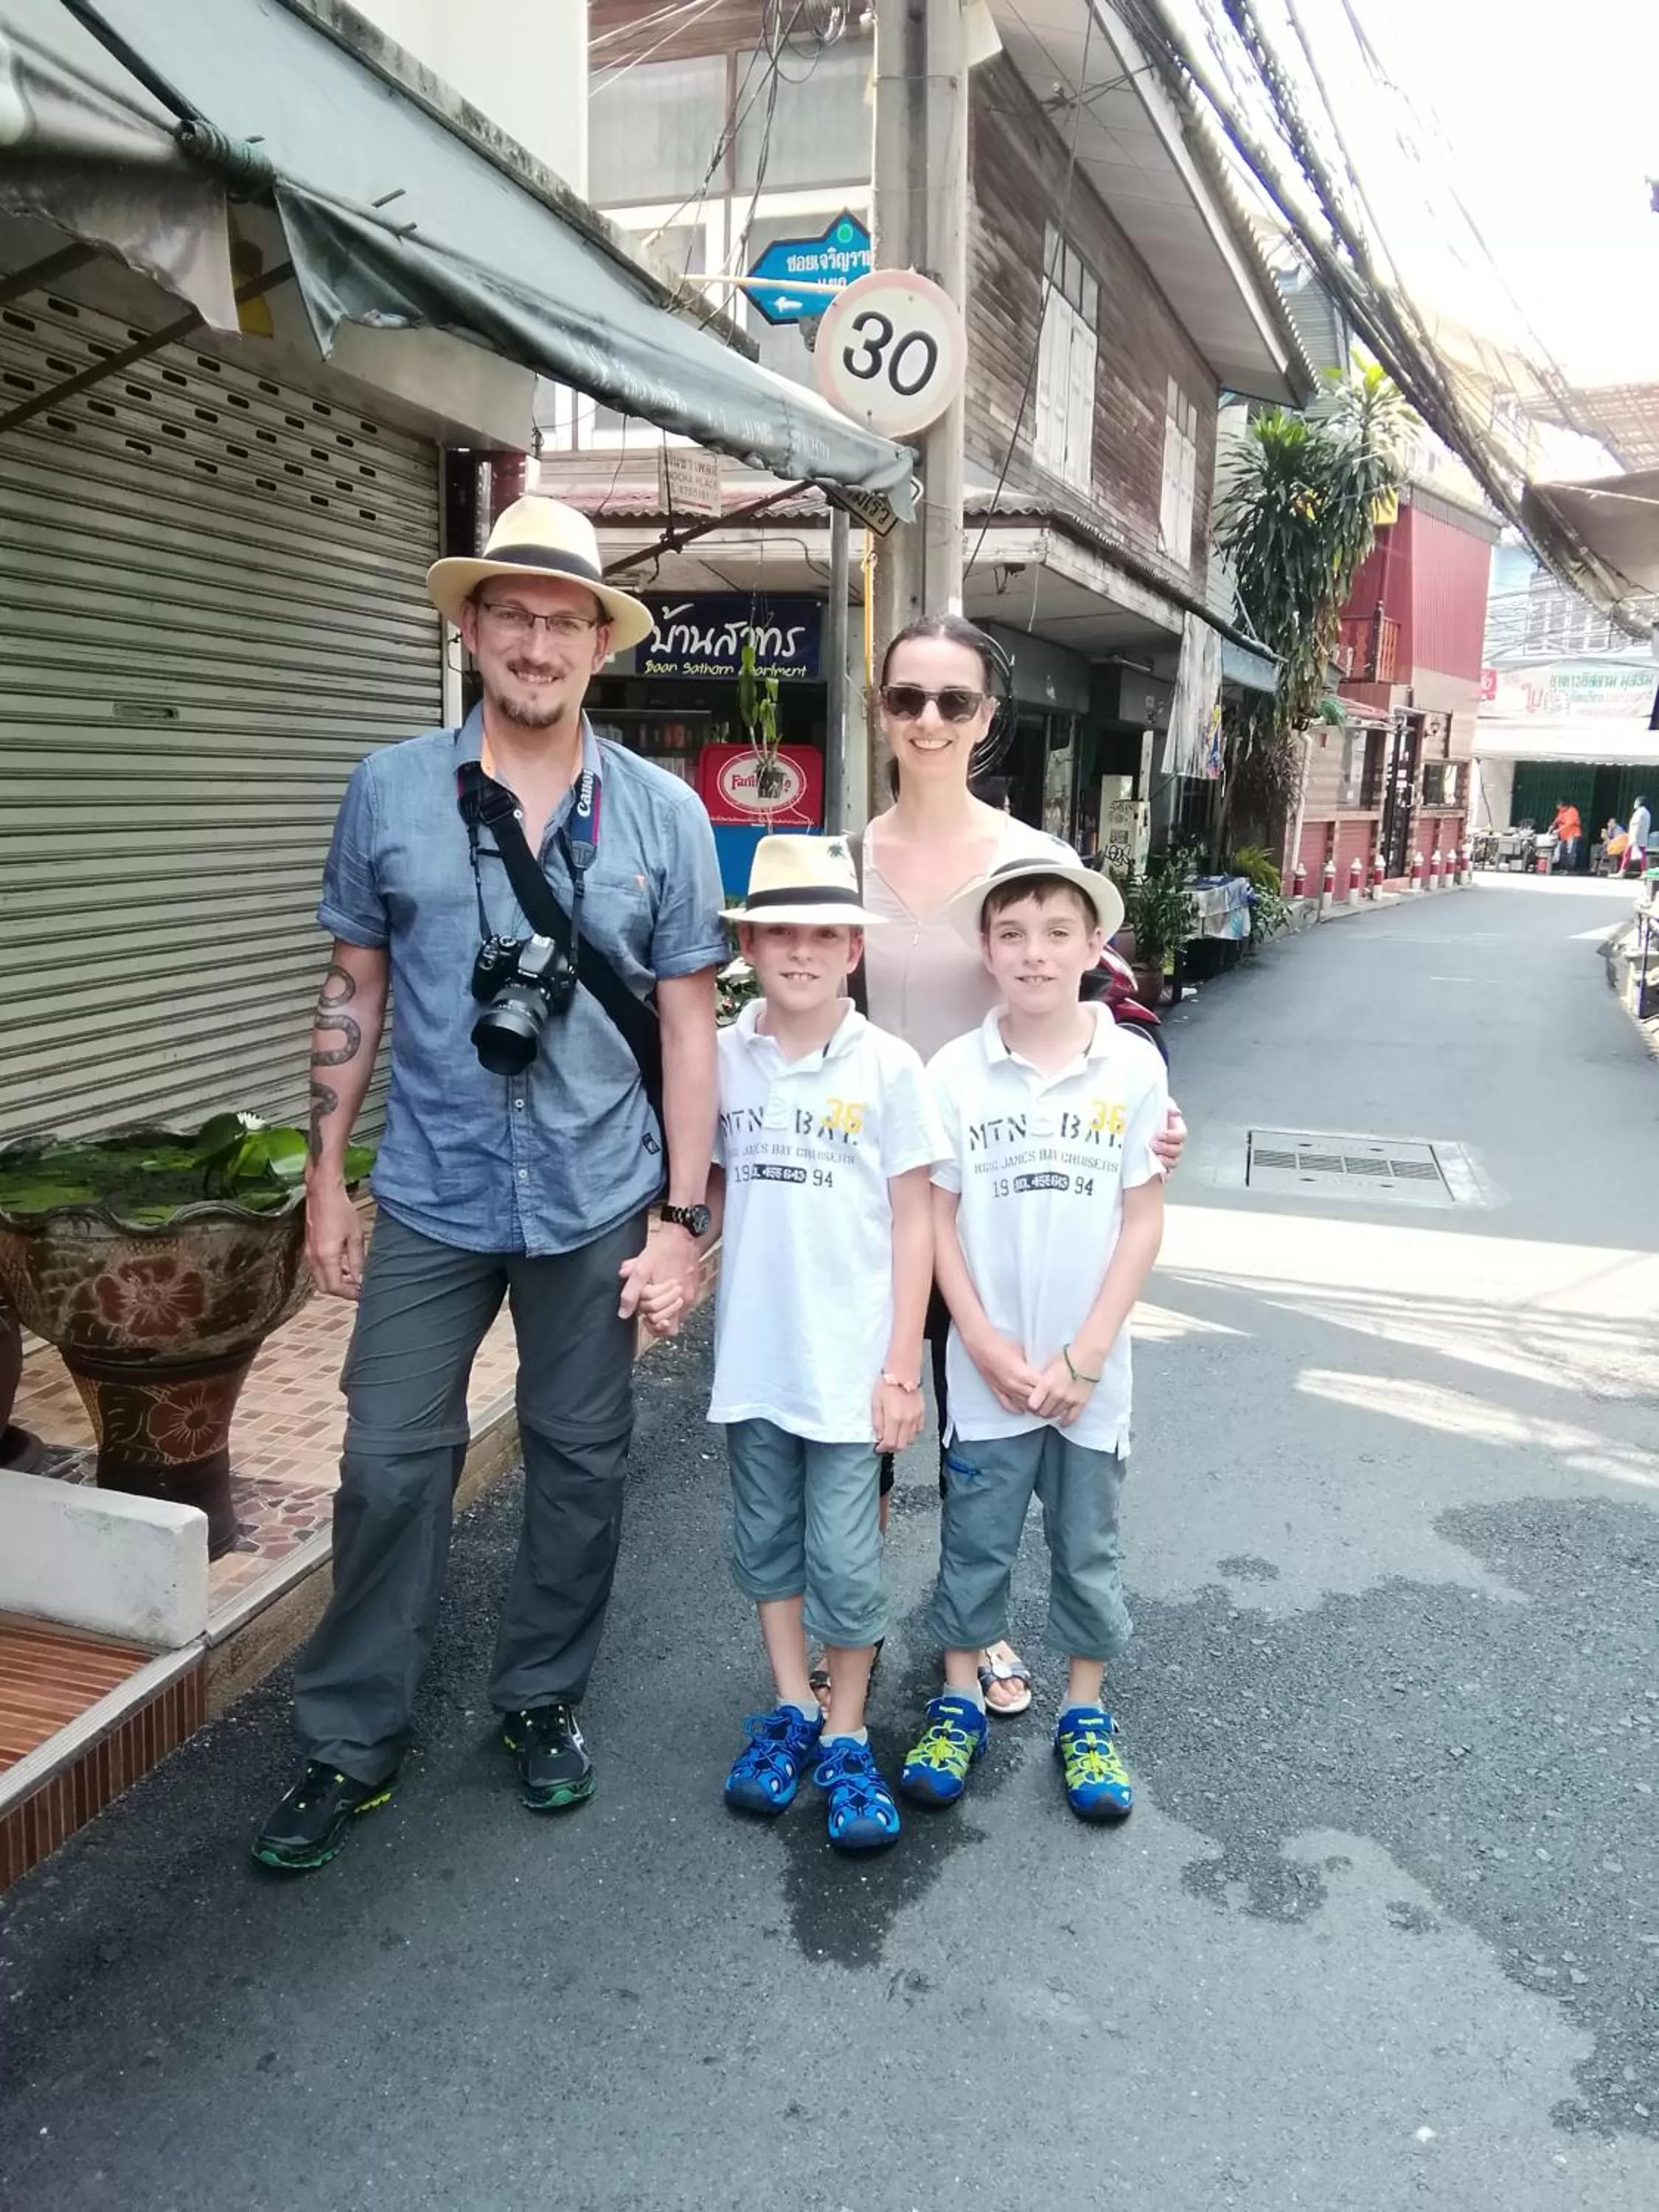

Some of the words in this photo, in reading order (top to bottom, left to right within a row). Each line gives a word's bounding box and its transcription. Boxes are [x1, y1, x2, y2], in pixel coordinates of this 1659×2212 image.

[843, 310, 938, 396] 30
[738, 664, 807, 677] artment
[969, 1113, 1026, 1151] MTN
[813, 1169, 834, 1188] 94
[1074, 1175, 1094, 1196] 94
